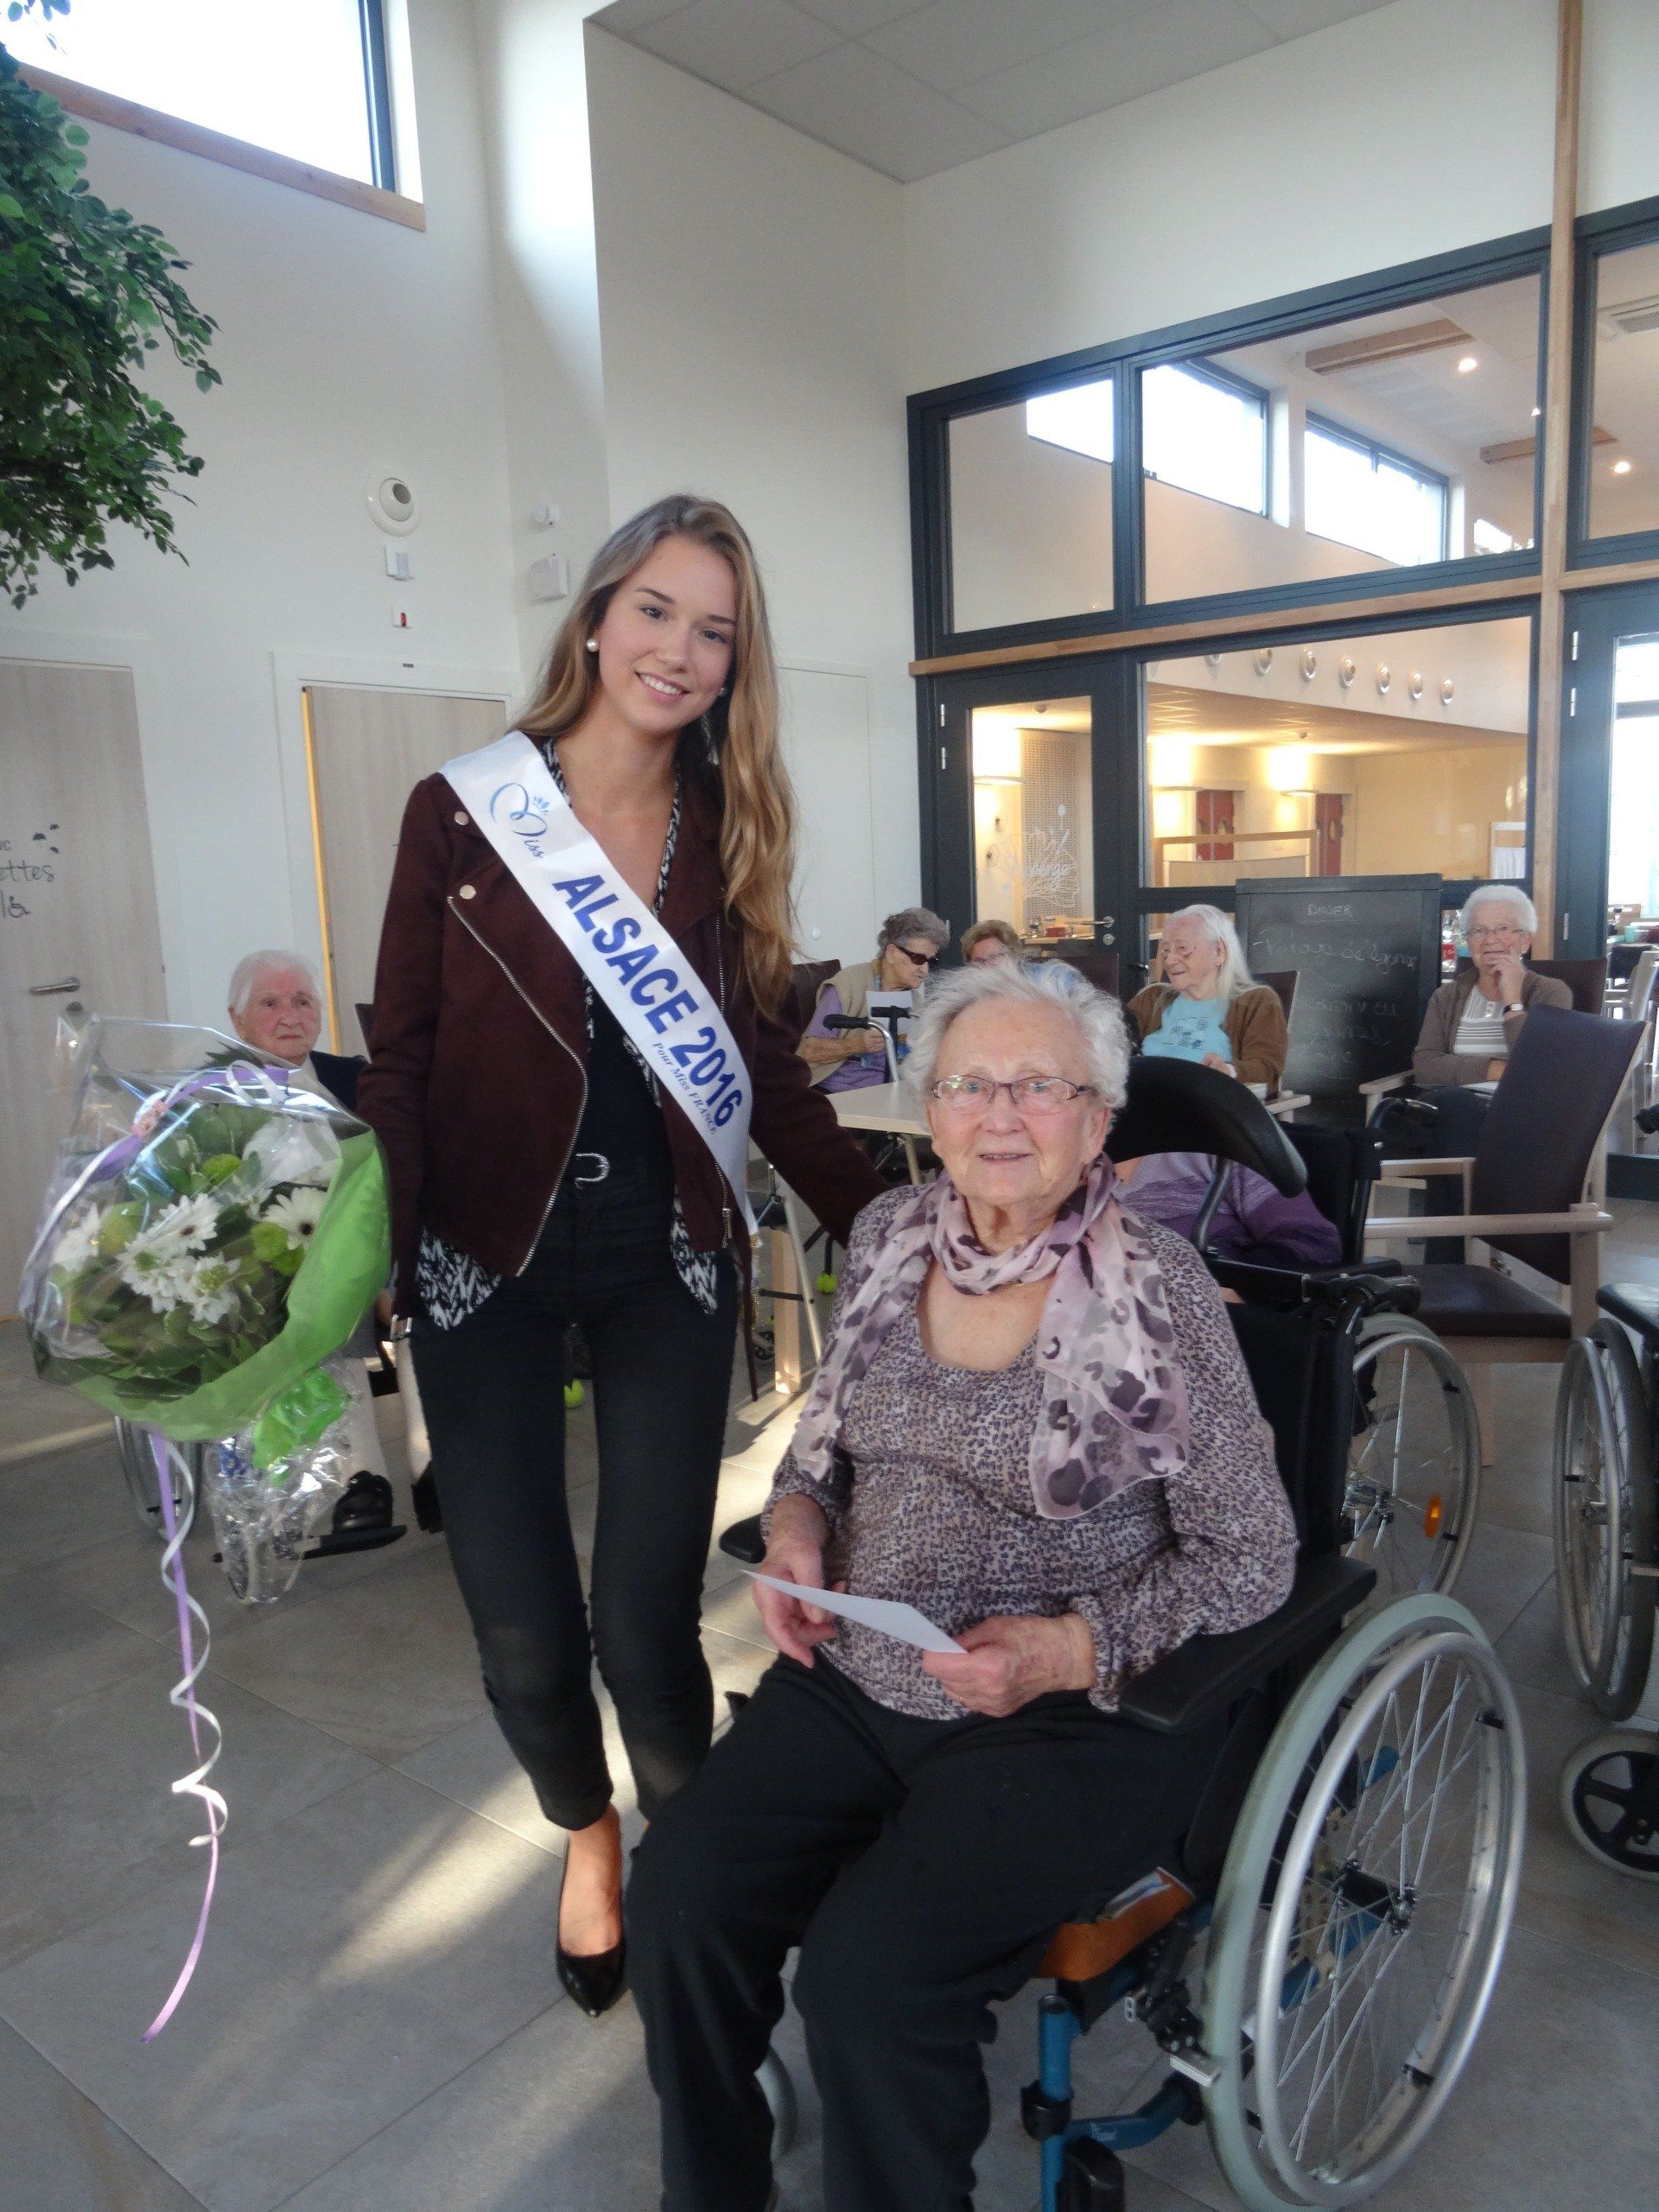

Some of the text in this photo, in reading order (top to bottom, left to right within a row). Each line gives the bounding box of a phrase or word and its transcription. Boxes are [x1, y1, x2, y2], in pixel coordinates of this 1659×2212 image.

[552, 874, 699, 1035] ALSACE
[669, 1026, 742, 1127] 2016
[652, 1042, 718, 1135] Pour Miss FRANCE
